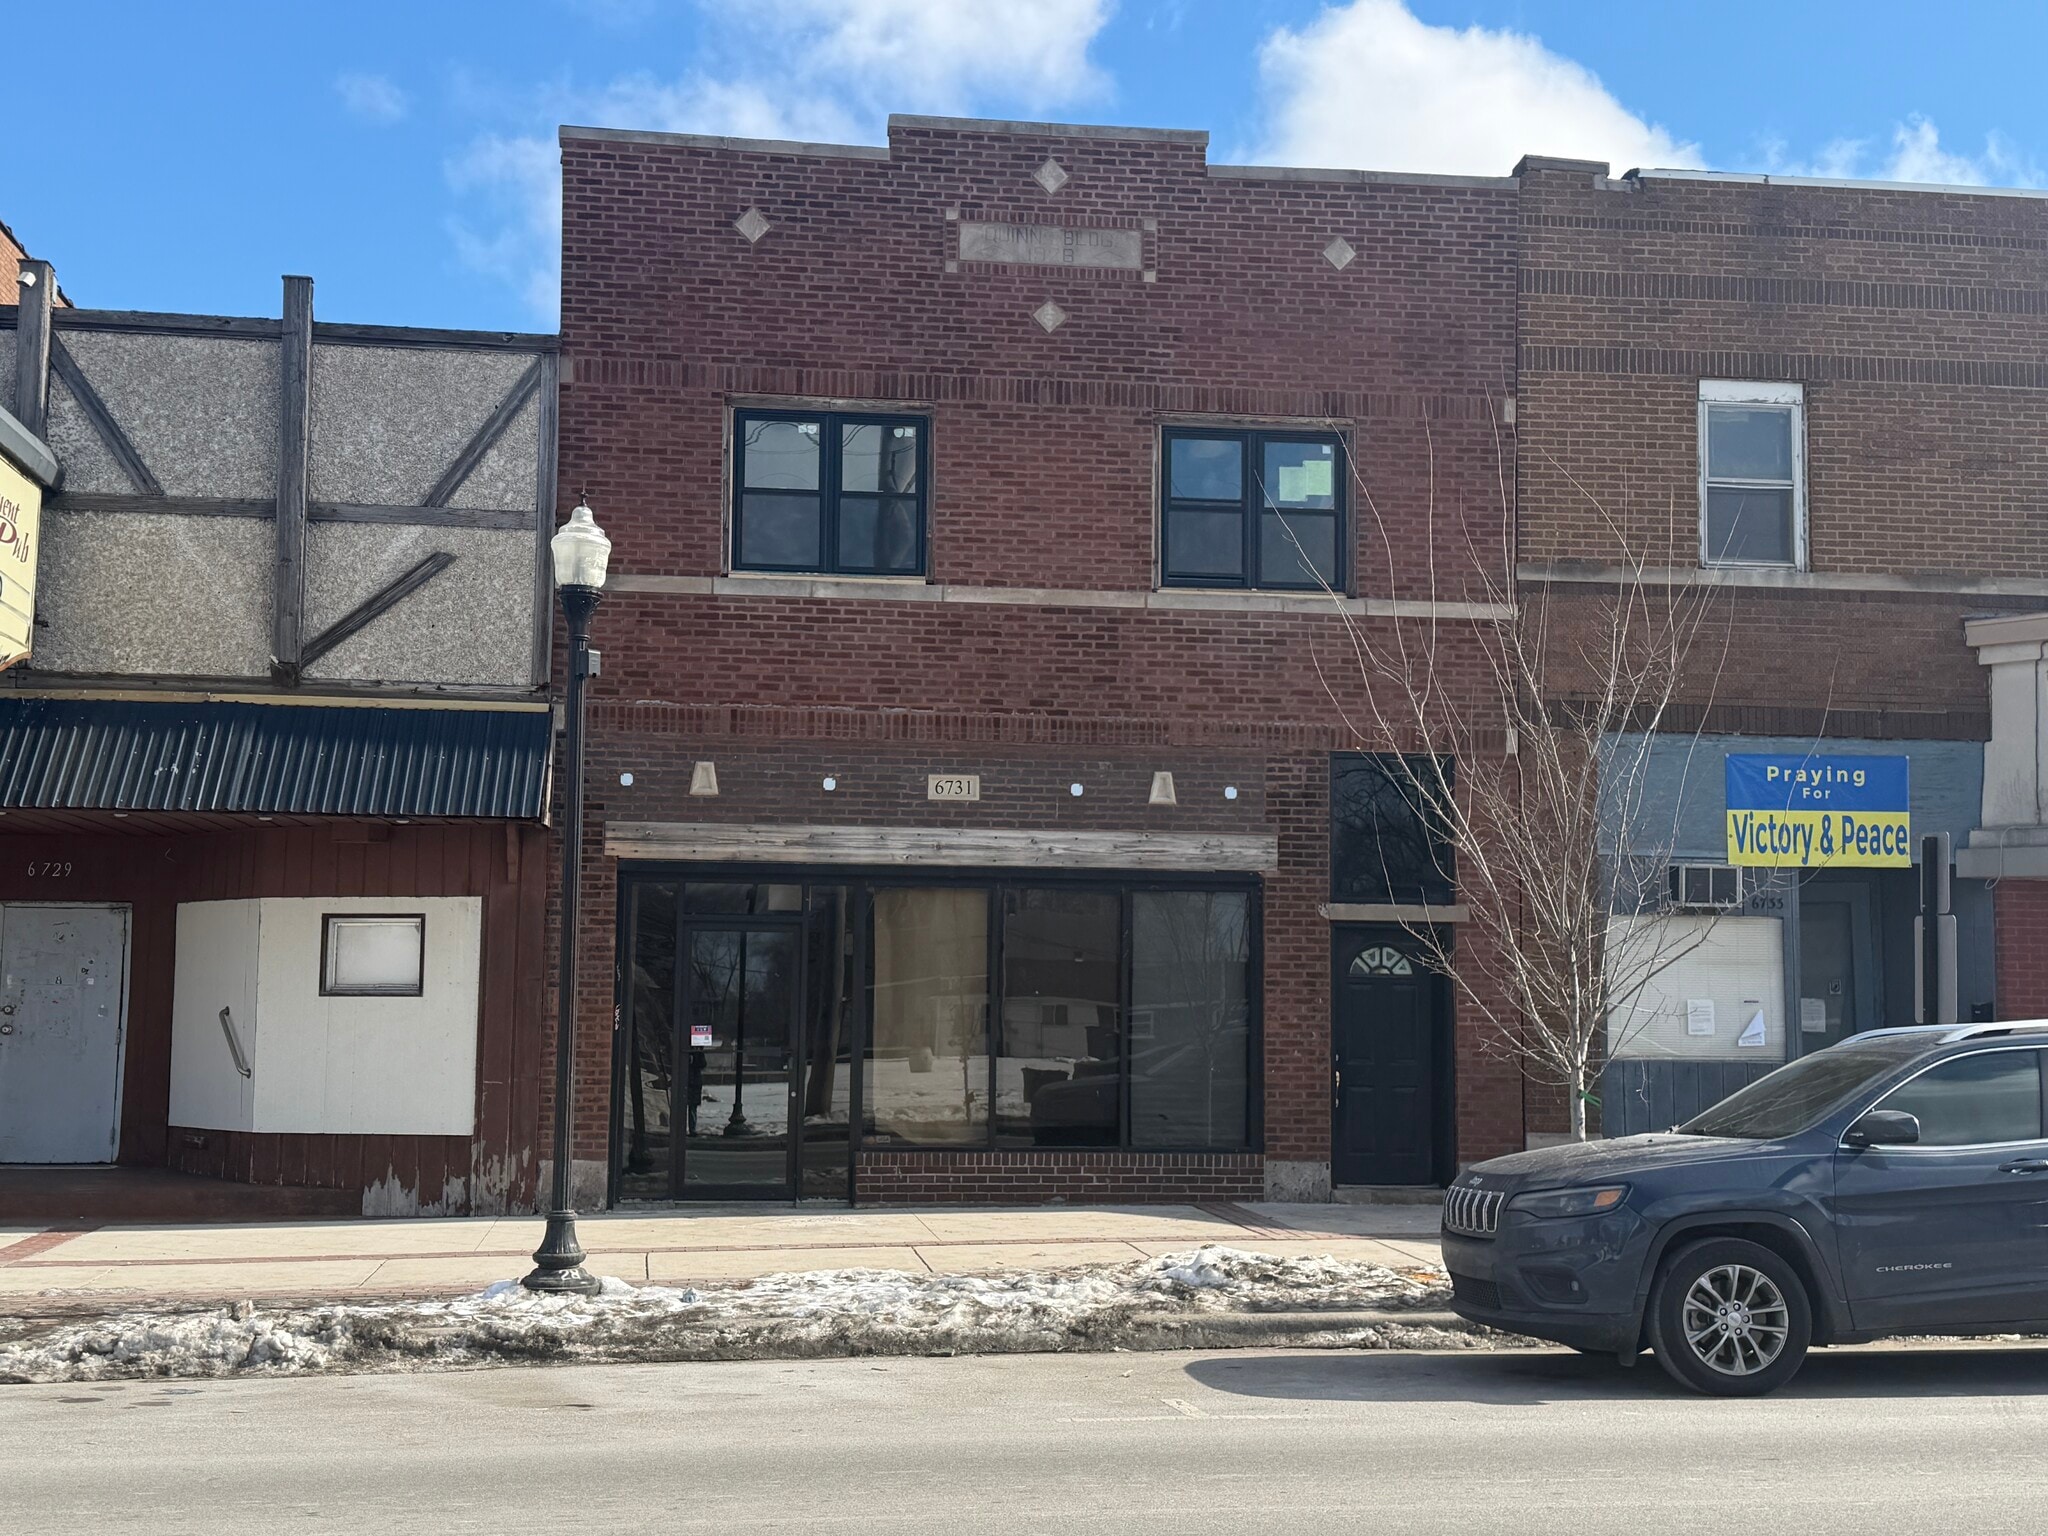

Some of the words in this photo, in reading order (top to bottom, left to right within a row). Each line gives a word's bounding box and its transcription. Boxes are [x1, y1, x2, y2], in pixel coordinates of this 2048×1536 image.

[984, 225, 1043, 245] QUINN
[1063, 229, 1114, 248] BLDG
[1766, 765, 1867, 787] Praying
[935, 780, 972, 795] 6731
[1802, 787, 1831, 799] For
[1732, 811, 1814, 866] Victory
[1819, 814, 1835, 856] &
[1841, 815, 1908, 856] Peace
[27, 861, 73, 877] 6729
[558, 1269, 581, 1280] 28
[1876, 1262, 1953, 1273] CHEROKEE
